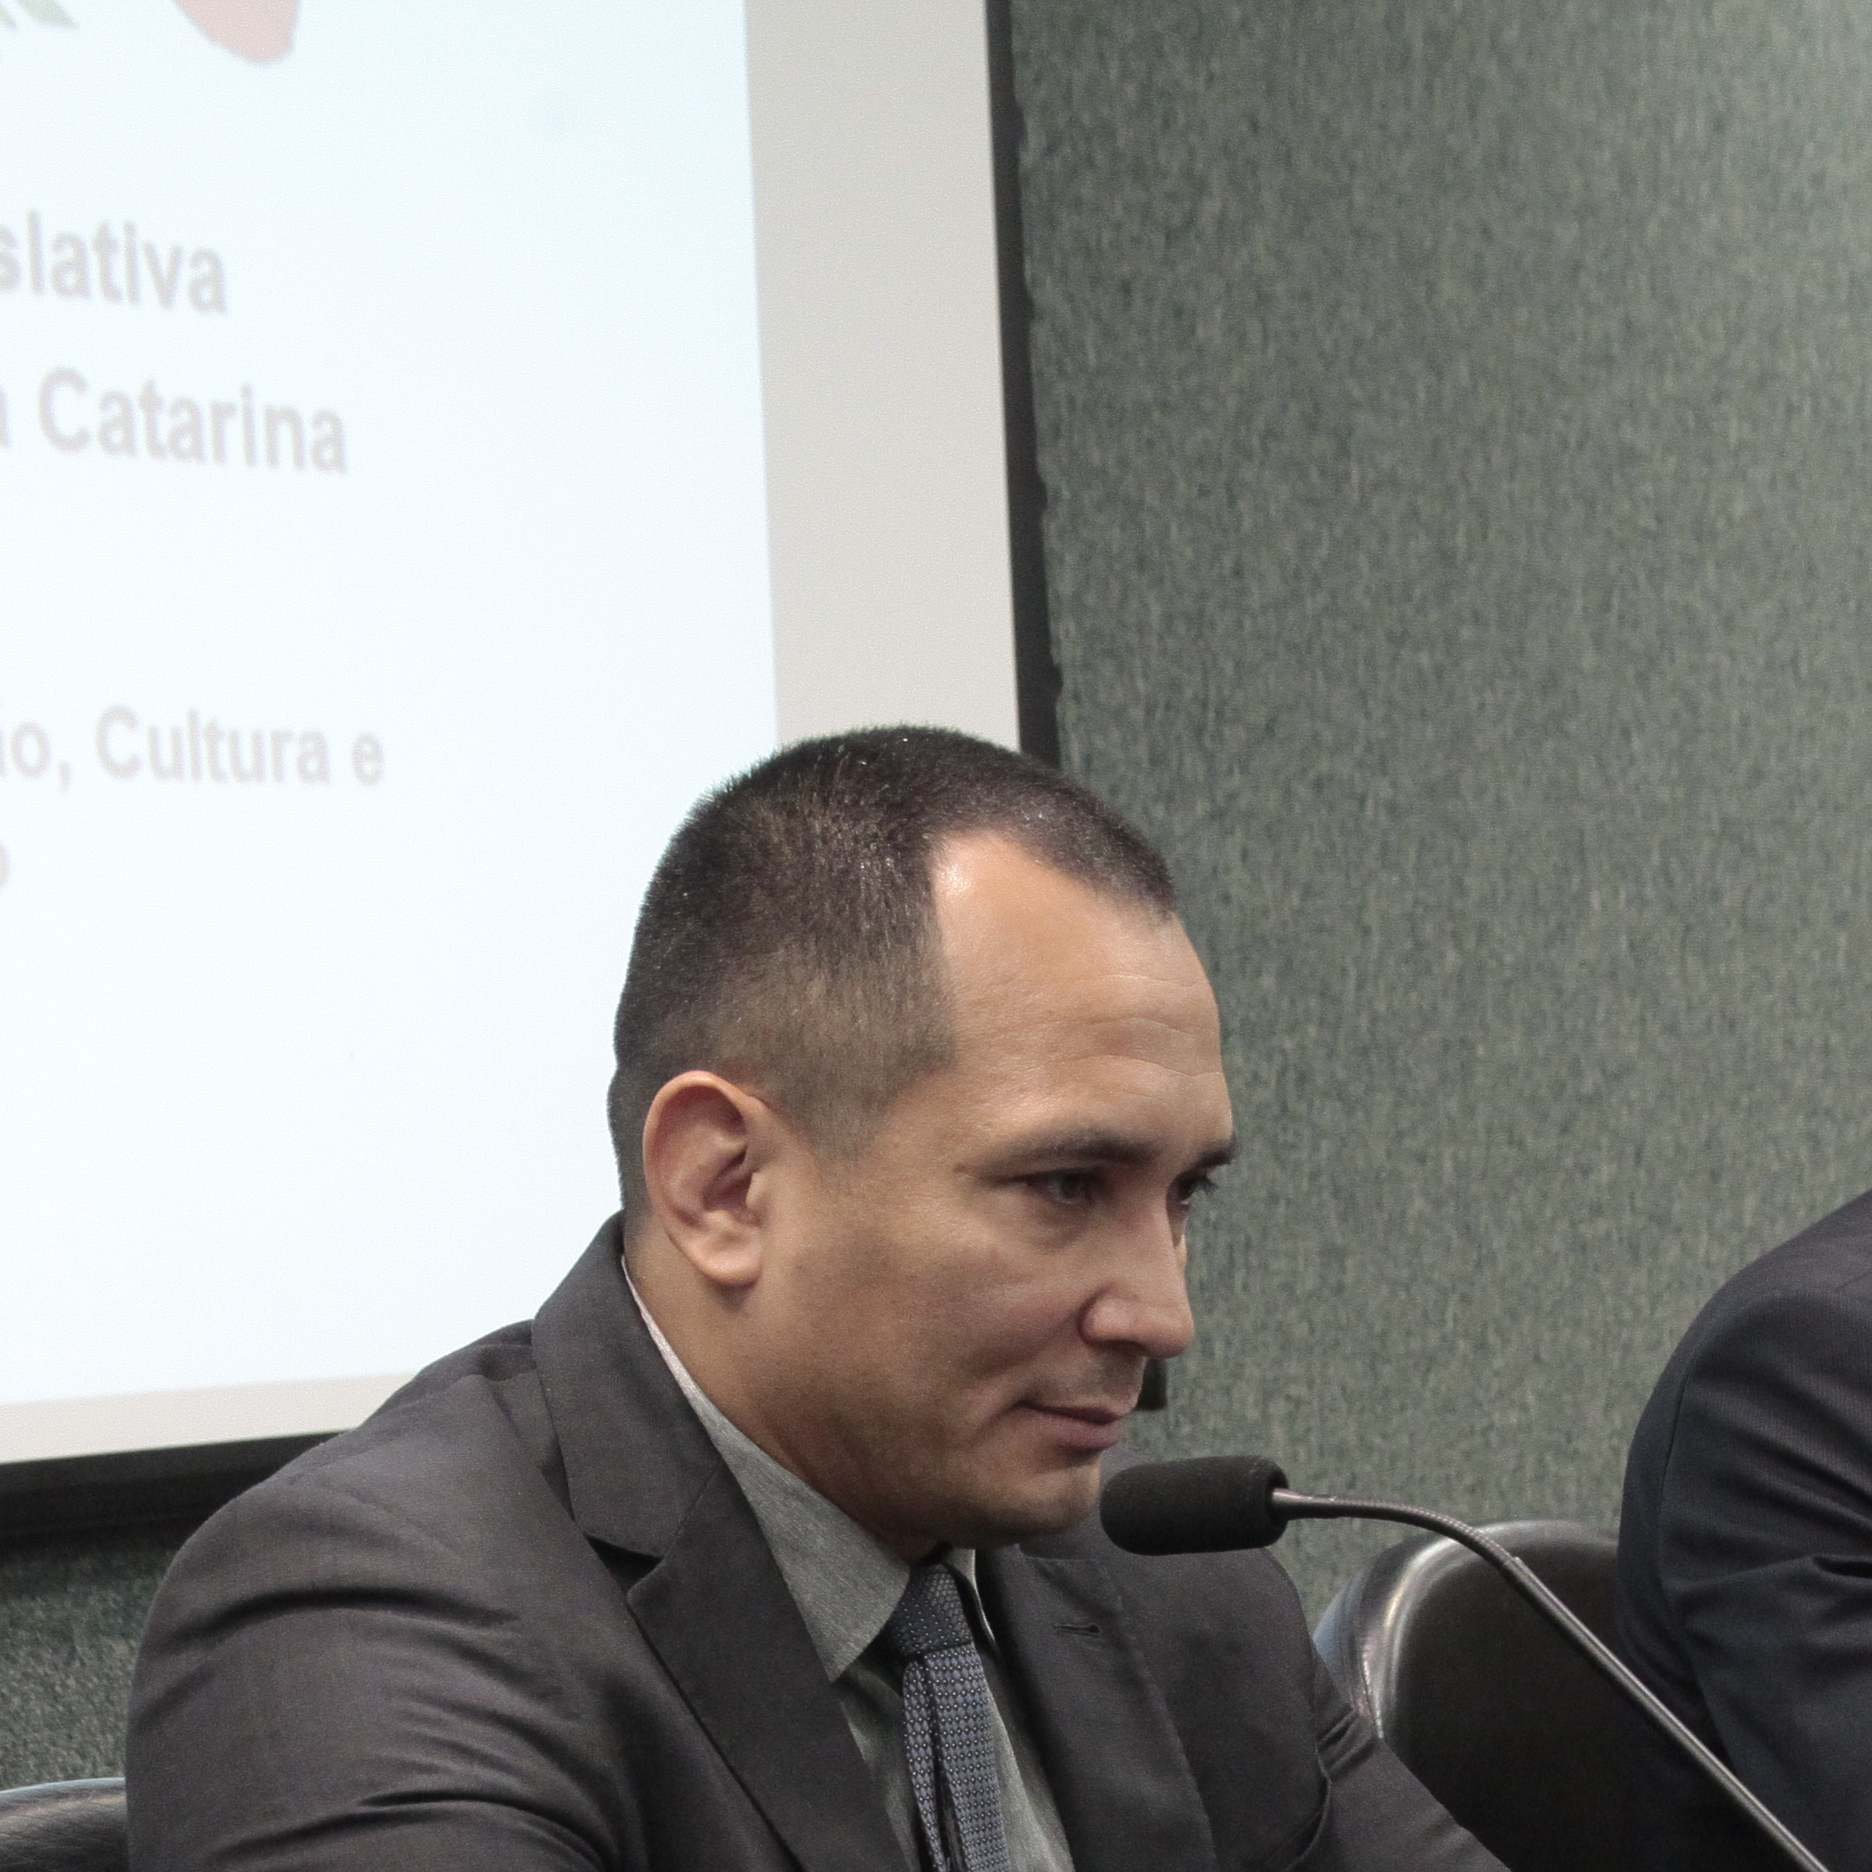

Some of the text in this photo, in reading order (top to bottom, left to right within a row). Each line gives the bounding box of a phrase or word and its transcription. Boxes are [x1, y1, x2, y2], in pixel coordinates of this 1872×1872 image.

[38, 368, 348, 475] Catarina
[95, 706, 331, 786] Cultura
[351, 733, 385, 786] e
